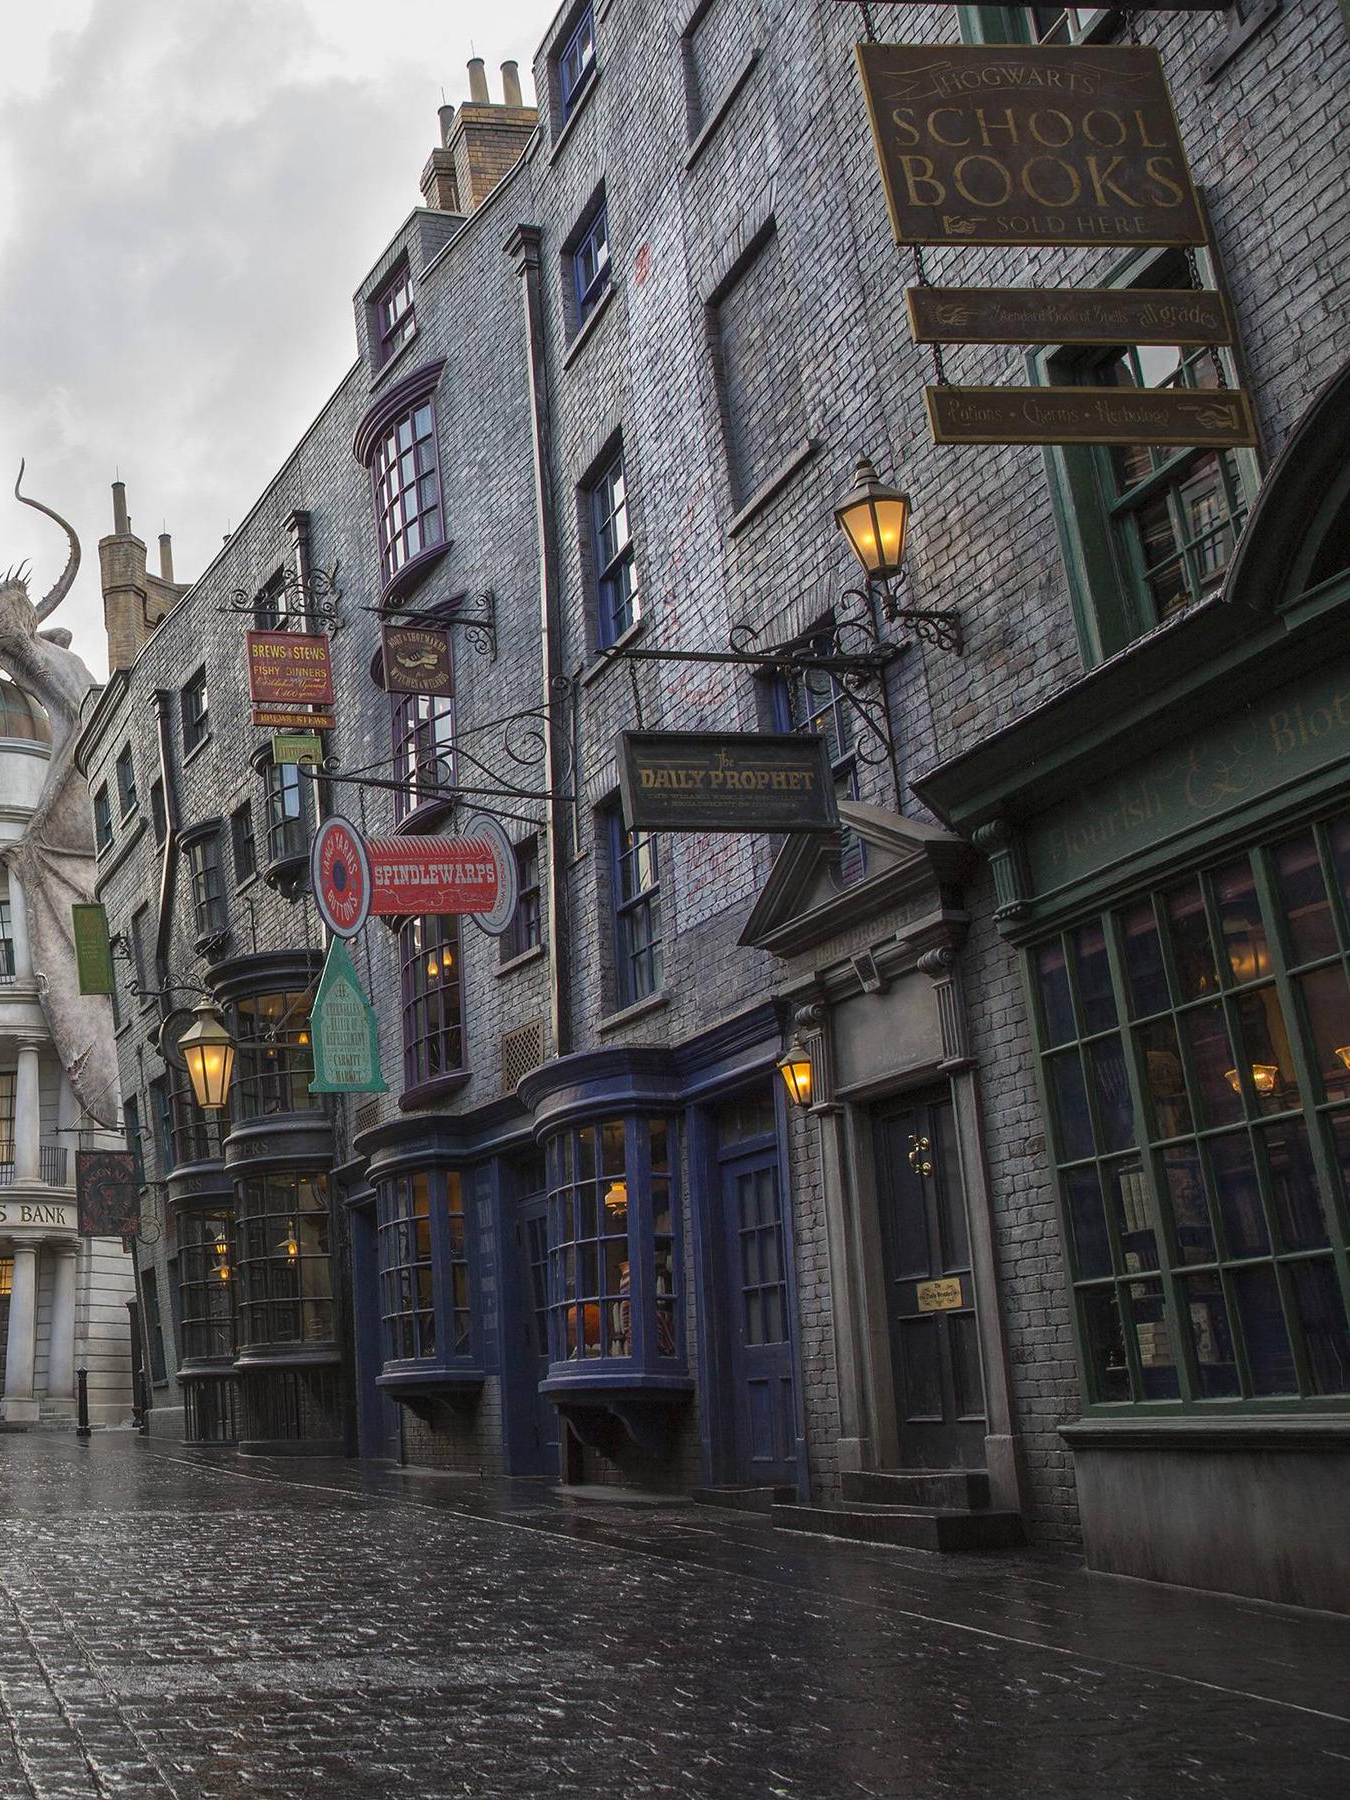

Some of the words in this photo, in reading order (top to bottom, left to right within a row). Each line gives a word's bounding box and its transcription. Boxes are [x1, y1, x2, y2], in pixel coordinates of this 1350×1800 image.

[939, 66, 1097, 97] HOGWARTS
[892, 107, 1168, 149] SCHOOL
[898, 155, 1186, 209] BOOKS
[997, 215, 1066, 236] SOLD
[1077, 217, 1149, 236] HERE
[1049, 305, 1079, 324] Book
[1094, 306, 1129, 325] Spells
[1137, 303, 1158, 328] all
[1160, 305, 1219, 329] grades
[947, 399, 1003, 428] Potions
[1023, 400, 1079, 426] Charms
[252, 644, 286, 658] BREWS
[293, 646, 326, 660] STEWS
[253, 665, 280, 675] FISHY
[286, 667, 327, 678] DINNERS
[640, 768, 705, 788] DAILY
[709, 771, 814, 790] PROPHET
[334, 832, 358, 875] YARNS
[374, 863, 496, 886] SPINDLEWARPS
[327, 890, 358, 922] BUTTONS
[20, 1205, 66, 1224] BANK
